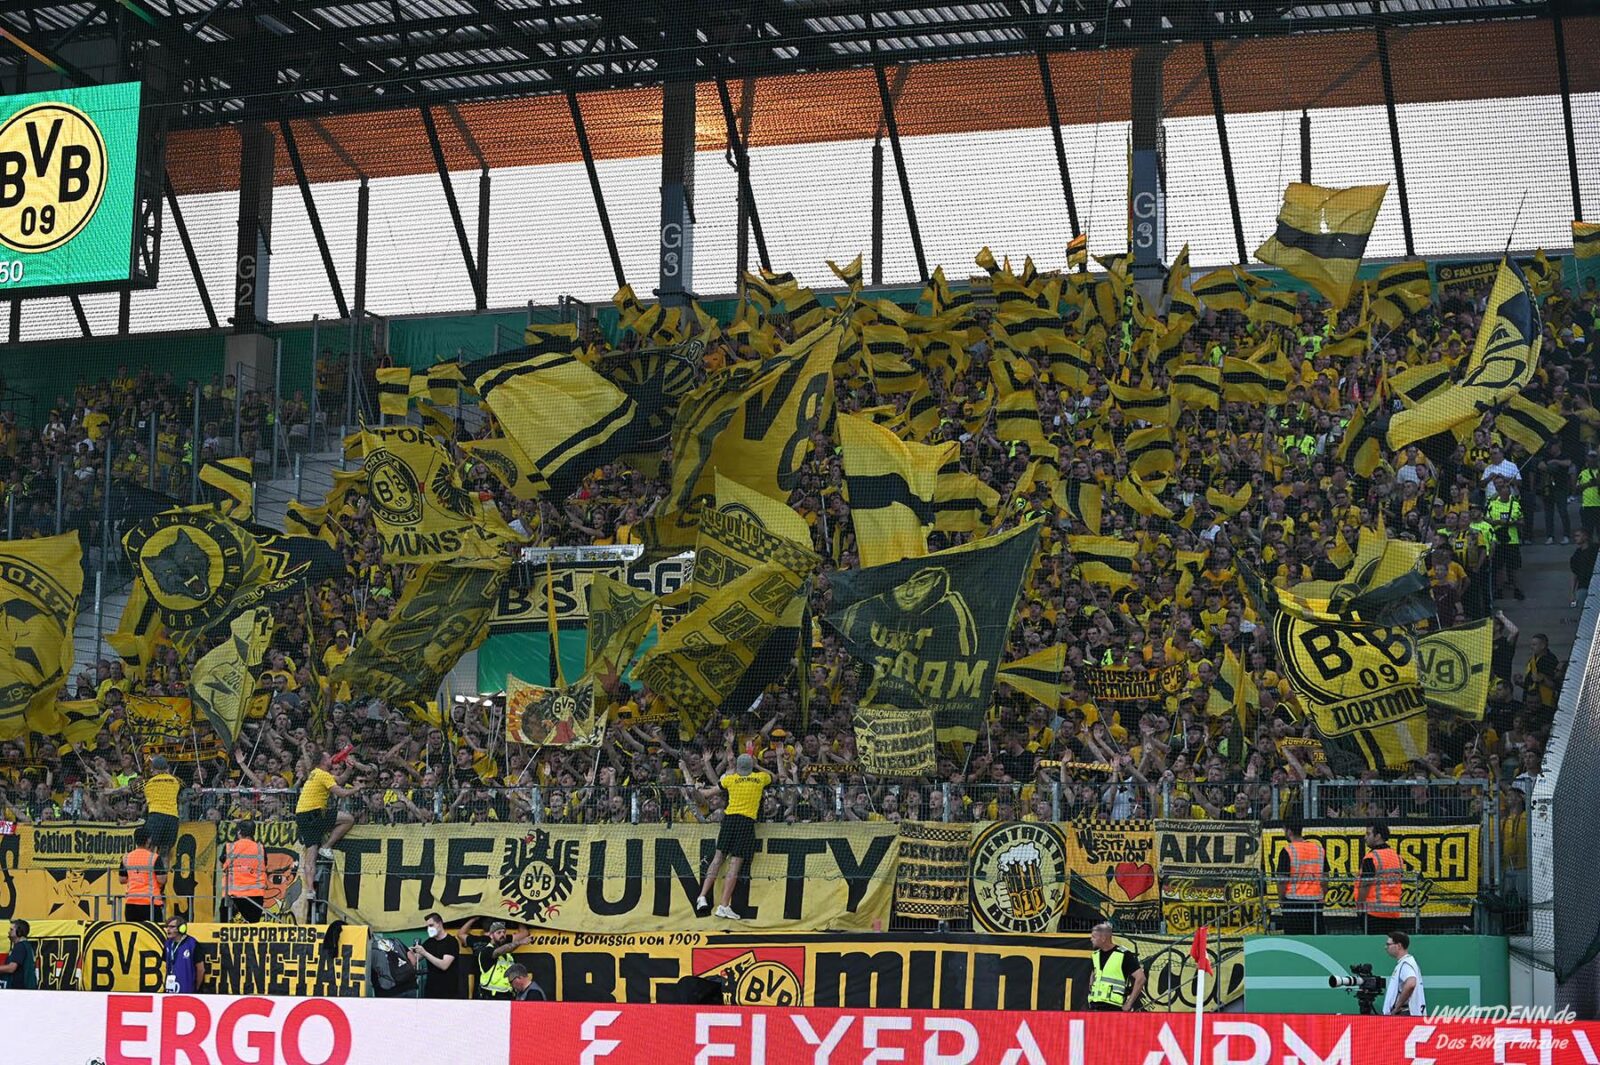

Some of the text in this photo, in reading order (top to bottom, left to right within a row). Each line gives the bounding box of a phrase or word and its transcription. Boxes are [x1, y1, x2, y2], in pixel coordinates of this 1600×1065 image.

[21, 205, 55, 236] 09
[1454, 263, 1495, 278] FAN CLUB
[1163, 665, 1183, 685] BVB
[1359, 664, 1399, 690] 09
[34, 829, 136, 854] Sektion Stadionve
[1076, 827, 1153, 853] WESTFALEN
[1160, 834, 1260, 864] AKLP
[1087, 851, 1145, 864] STADION
[331, 838, 495, 913] THE
[524, 866, 551, 890] BVB
[530, 889, 540, 898] 09
[1233, 884, 1252, 899] BVB
[1172, 908, 1191, 924] BVB
[220, 927, 317, 942] SUPPORTERS
[574, 932, 635, 946] Borussia
[639, 935, 665, 946] von
[669, 933, 701, 946] 1909
[91, 931, 164, 992] BVB
[745, 969, 793, 1006] BVB
[104, 994, 352, 1065] ERGO
